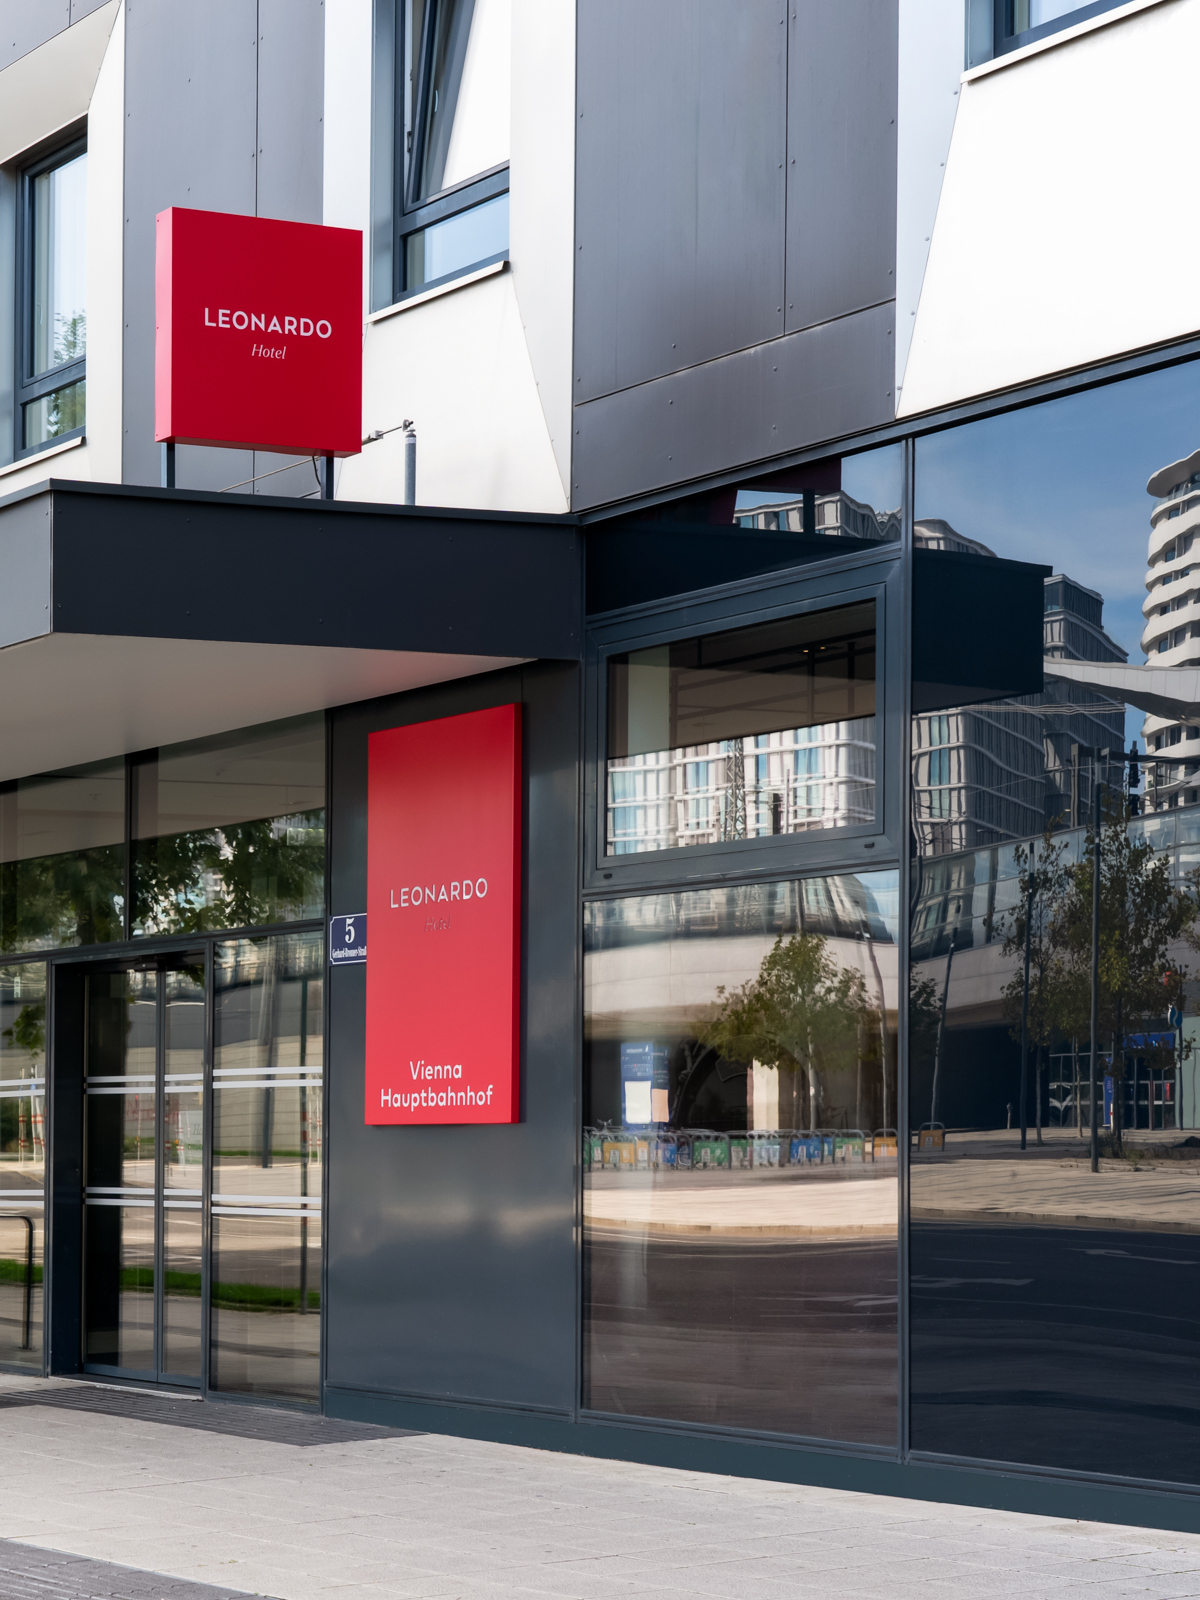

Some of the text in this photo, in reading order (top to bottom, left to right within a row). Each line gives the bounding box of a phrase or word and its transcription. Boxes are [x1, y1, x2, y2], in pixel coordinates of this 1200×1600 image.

[204, 307, 332, 339] LEONARDO
[251, 343, 287, 360] Hotel
[390, 877, 488, 909] LEONARDO
[345, 917, 355, 944] 5
[424, 914, 452, 932] Hotel
[409, 1060, 463, 1080] Vienna
[380, 1085, 494, 1112] Hauptbahnhof
